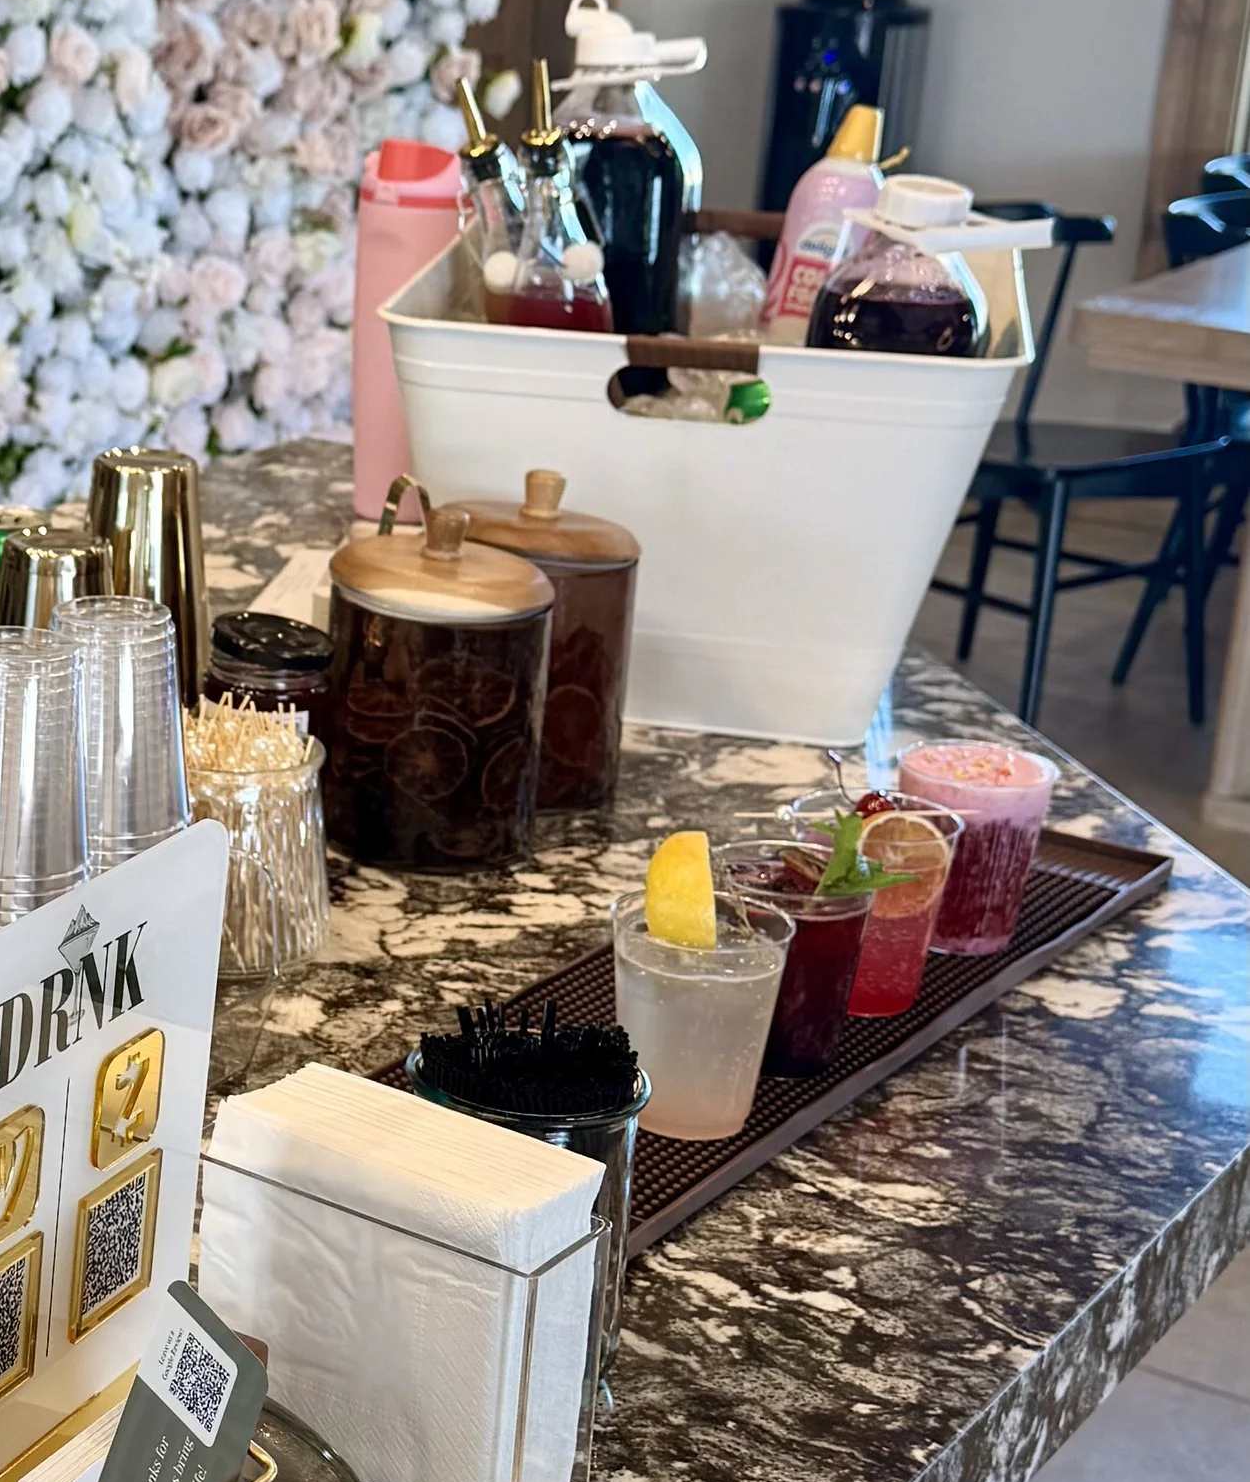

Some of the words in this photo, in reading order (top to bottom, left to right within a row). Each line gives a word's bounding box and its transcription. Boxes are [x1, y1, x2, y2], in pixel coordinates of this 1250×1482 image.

[162, 1355, 174, 1380] Google
[155, 1435, 170, 1456] for
[175, 1436, 195, 1479] bring
